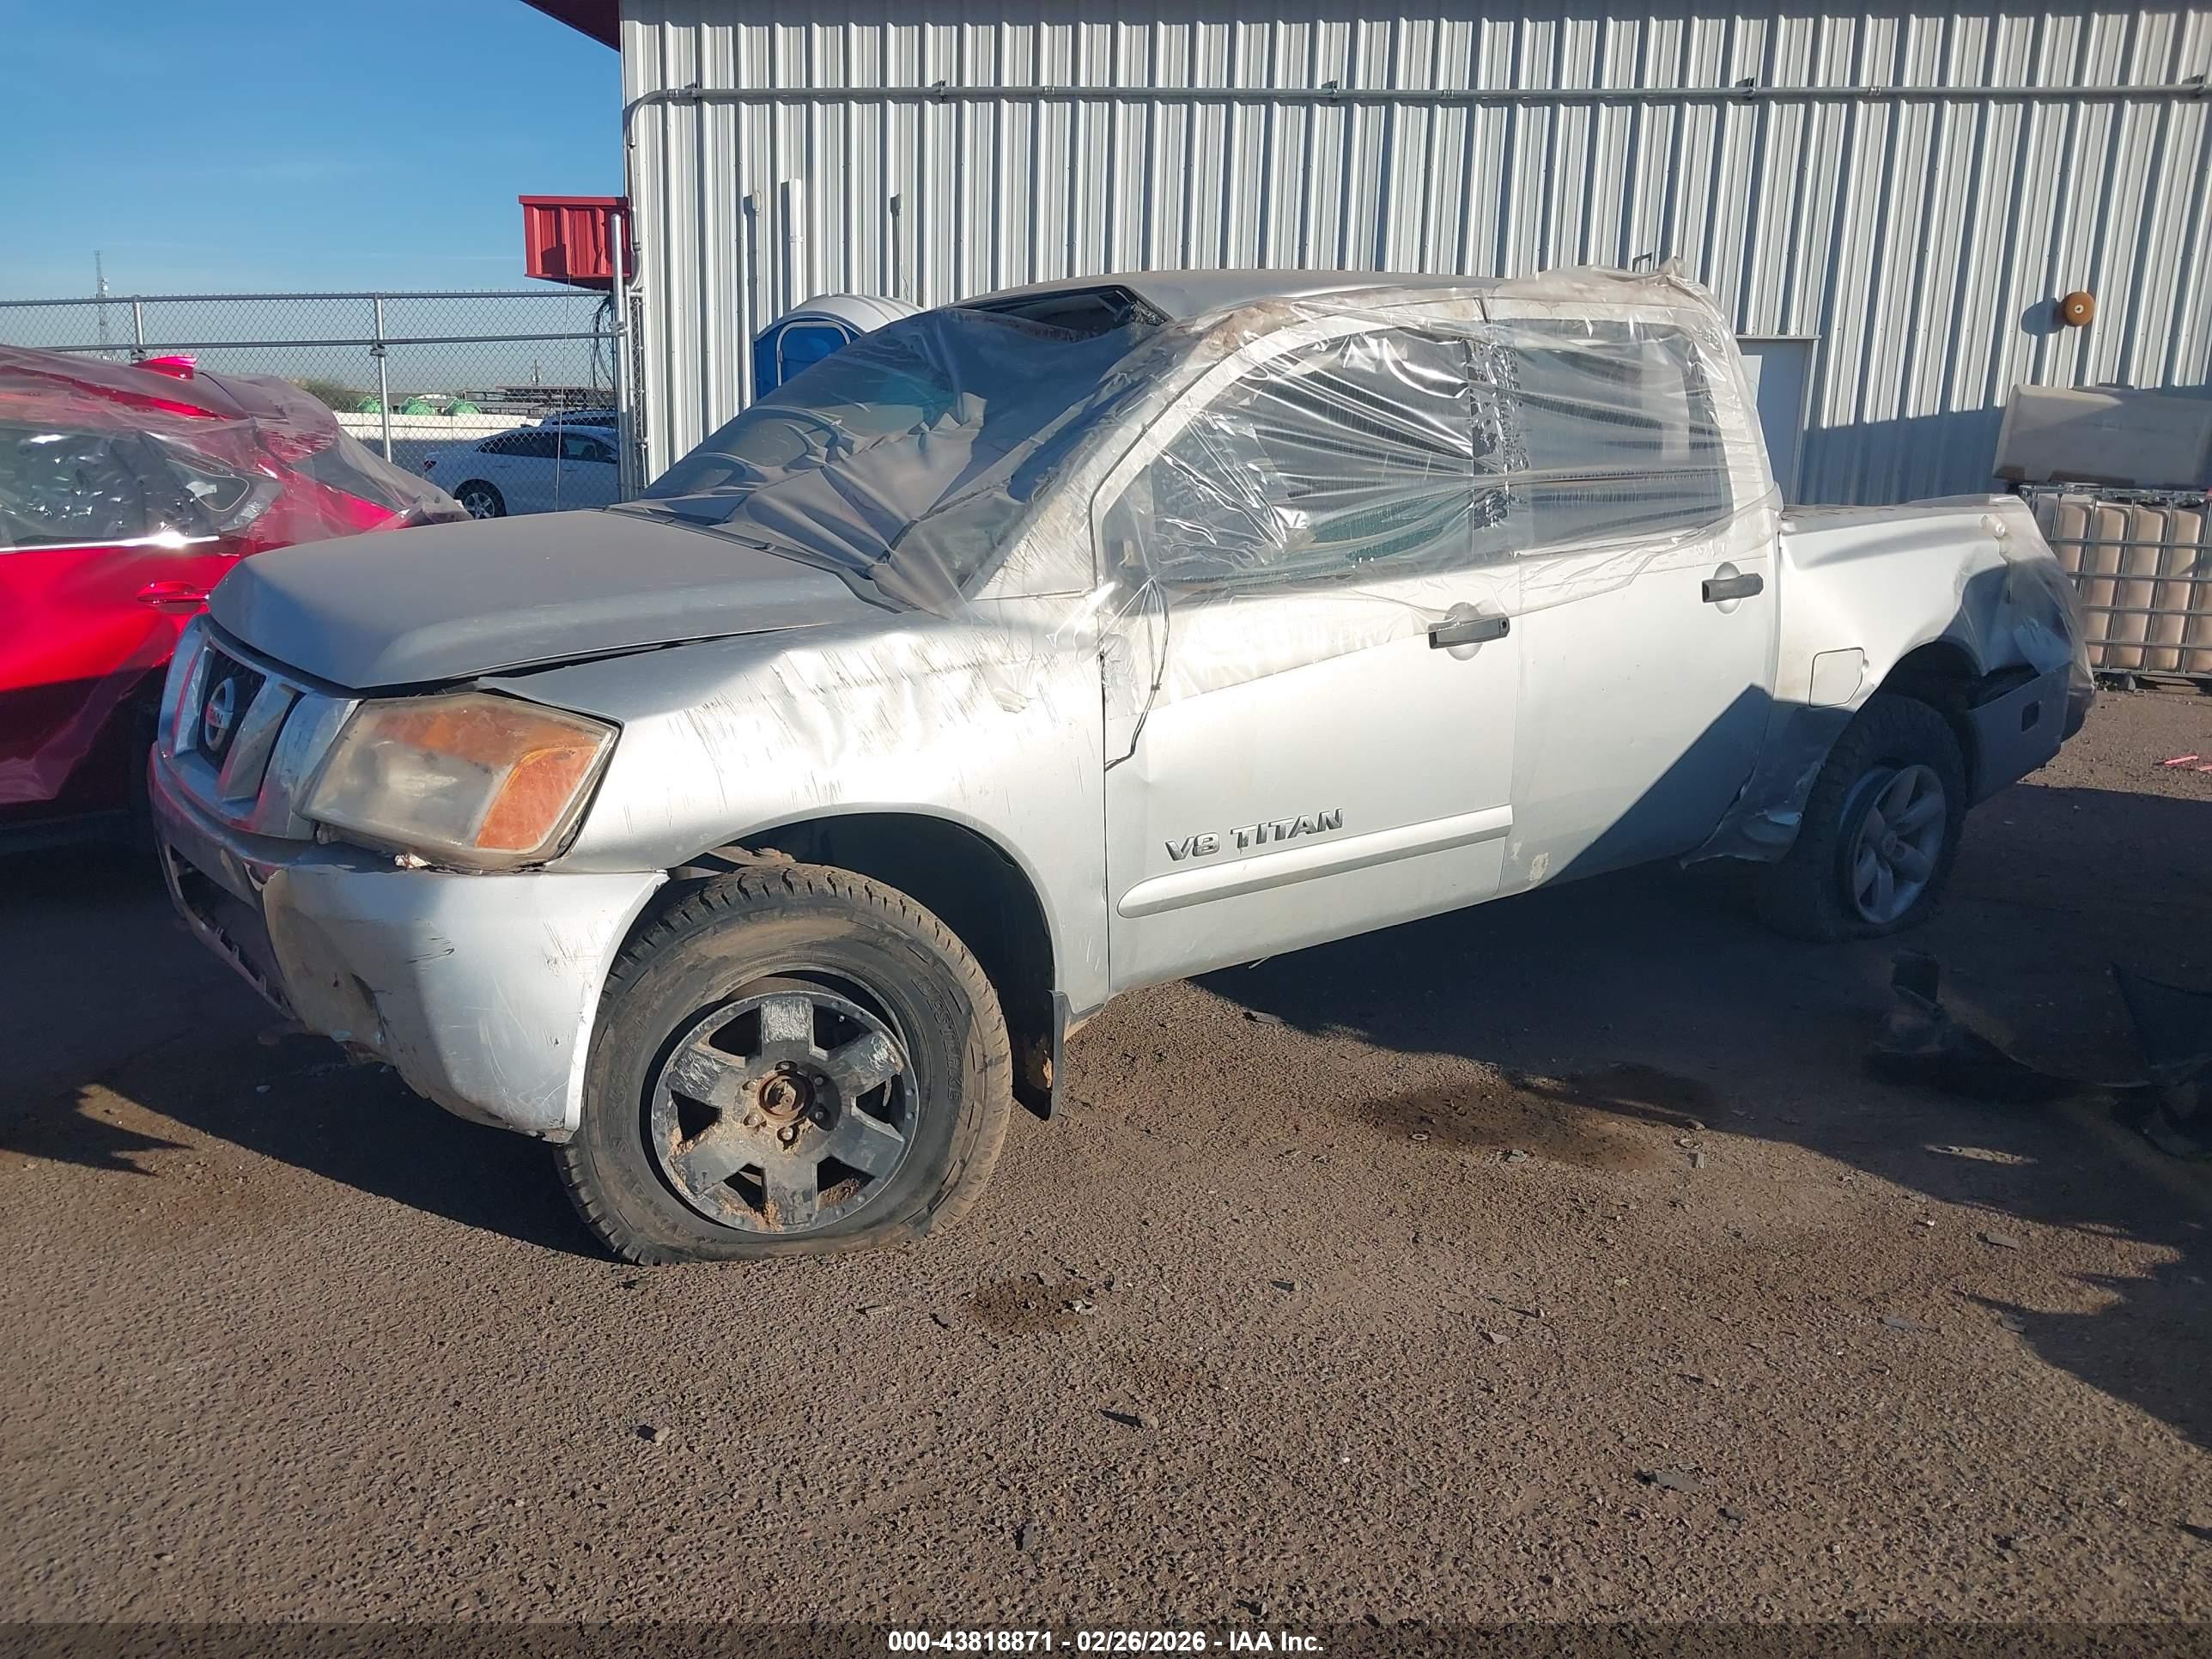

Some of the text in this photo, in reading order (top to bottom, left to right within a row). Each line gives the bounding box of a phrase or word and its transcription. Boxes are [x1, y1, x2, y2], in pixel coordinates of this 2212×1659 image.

[1164, 808, 1343, 861] V8 TITAN
[911, 975, 963, 1101] WESTLAKE
